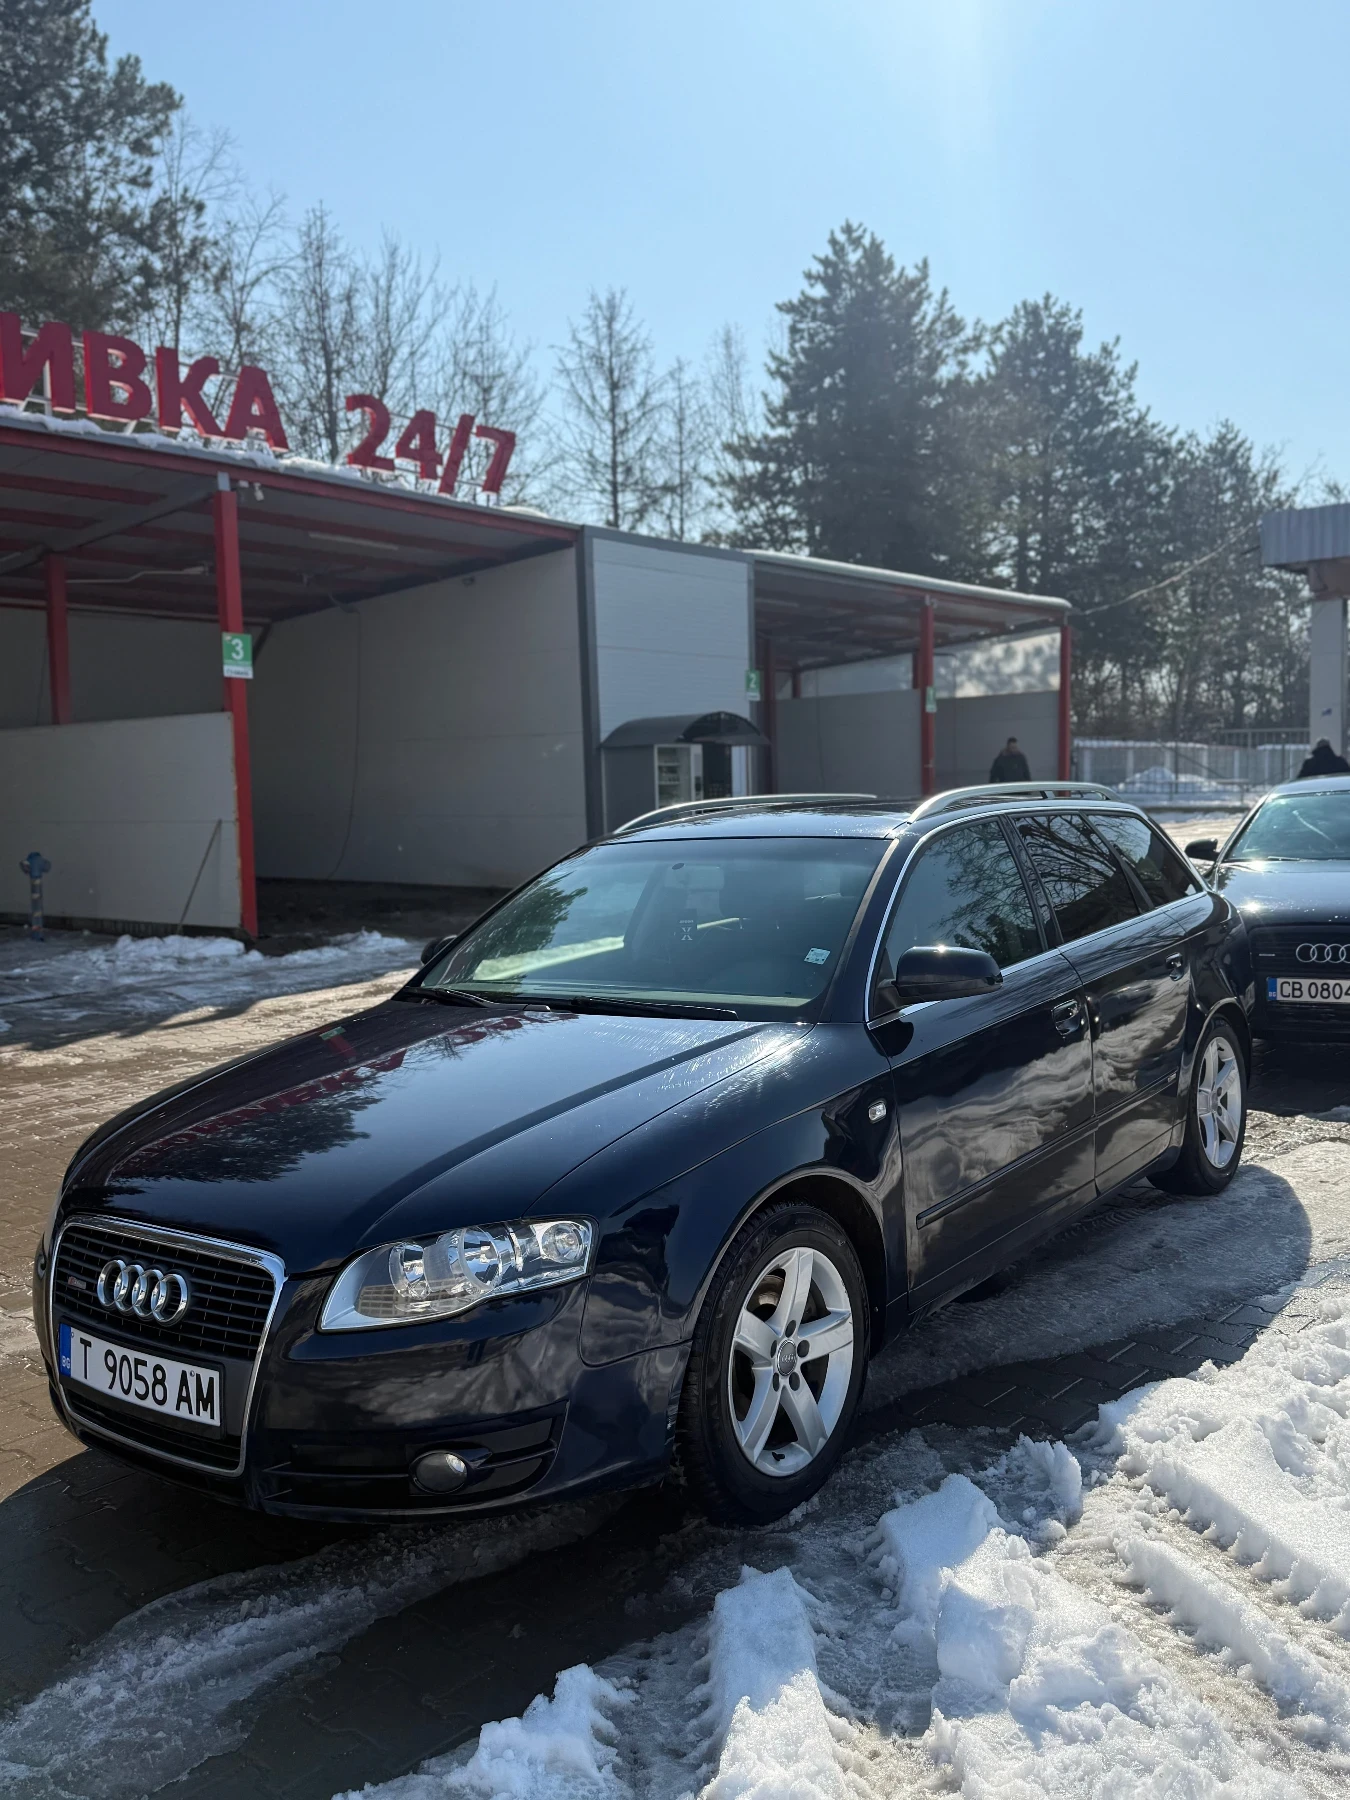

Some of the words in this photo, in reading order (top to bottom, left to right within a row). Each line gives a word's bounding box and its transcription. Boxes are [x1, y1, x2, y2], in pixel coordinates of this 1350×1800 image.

[0, 311, 289, 452] ИВКА
[345, 394, 516, 497] 24/7
[231, 638, 245, 661] 3
[749, 672, 757, 689] 2
[1308, 981, 1350, 1000] 0804
[62, 1354, 71, 1370] BG
[80, 1337, 92, 1380] T
[104, 1348, 168, 1406] 9058
[175, 1369, 216, 1421] AM
